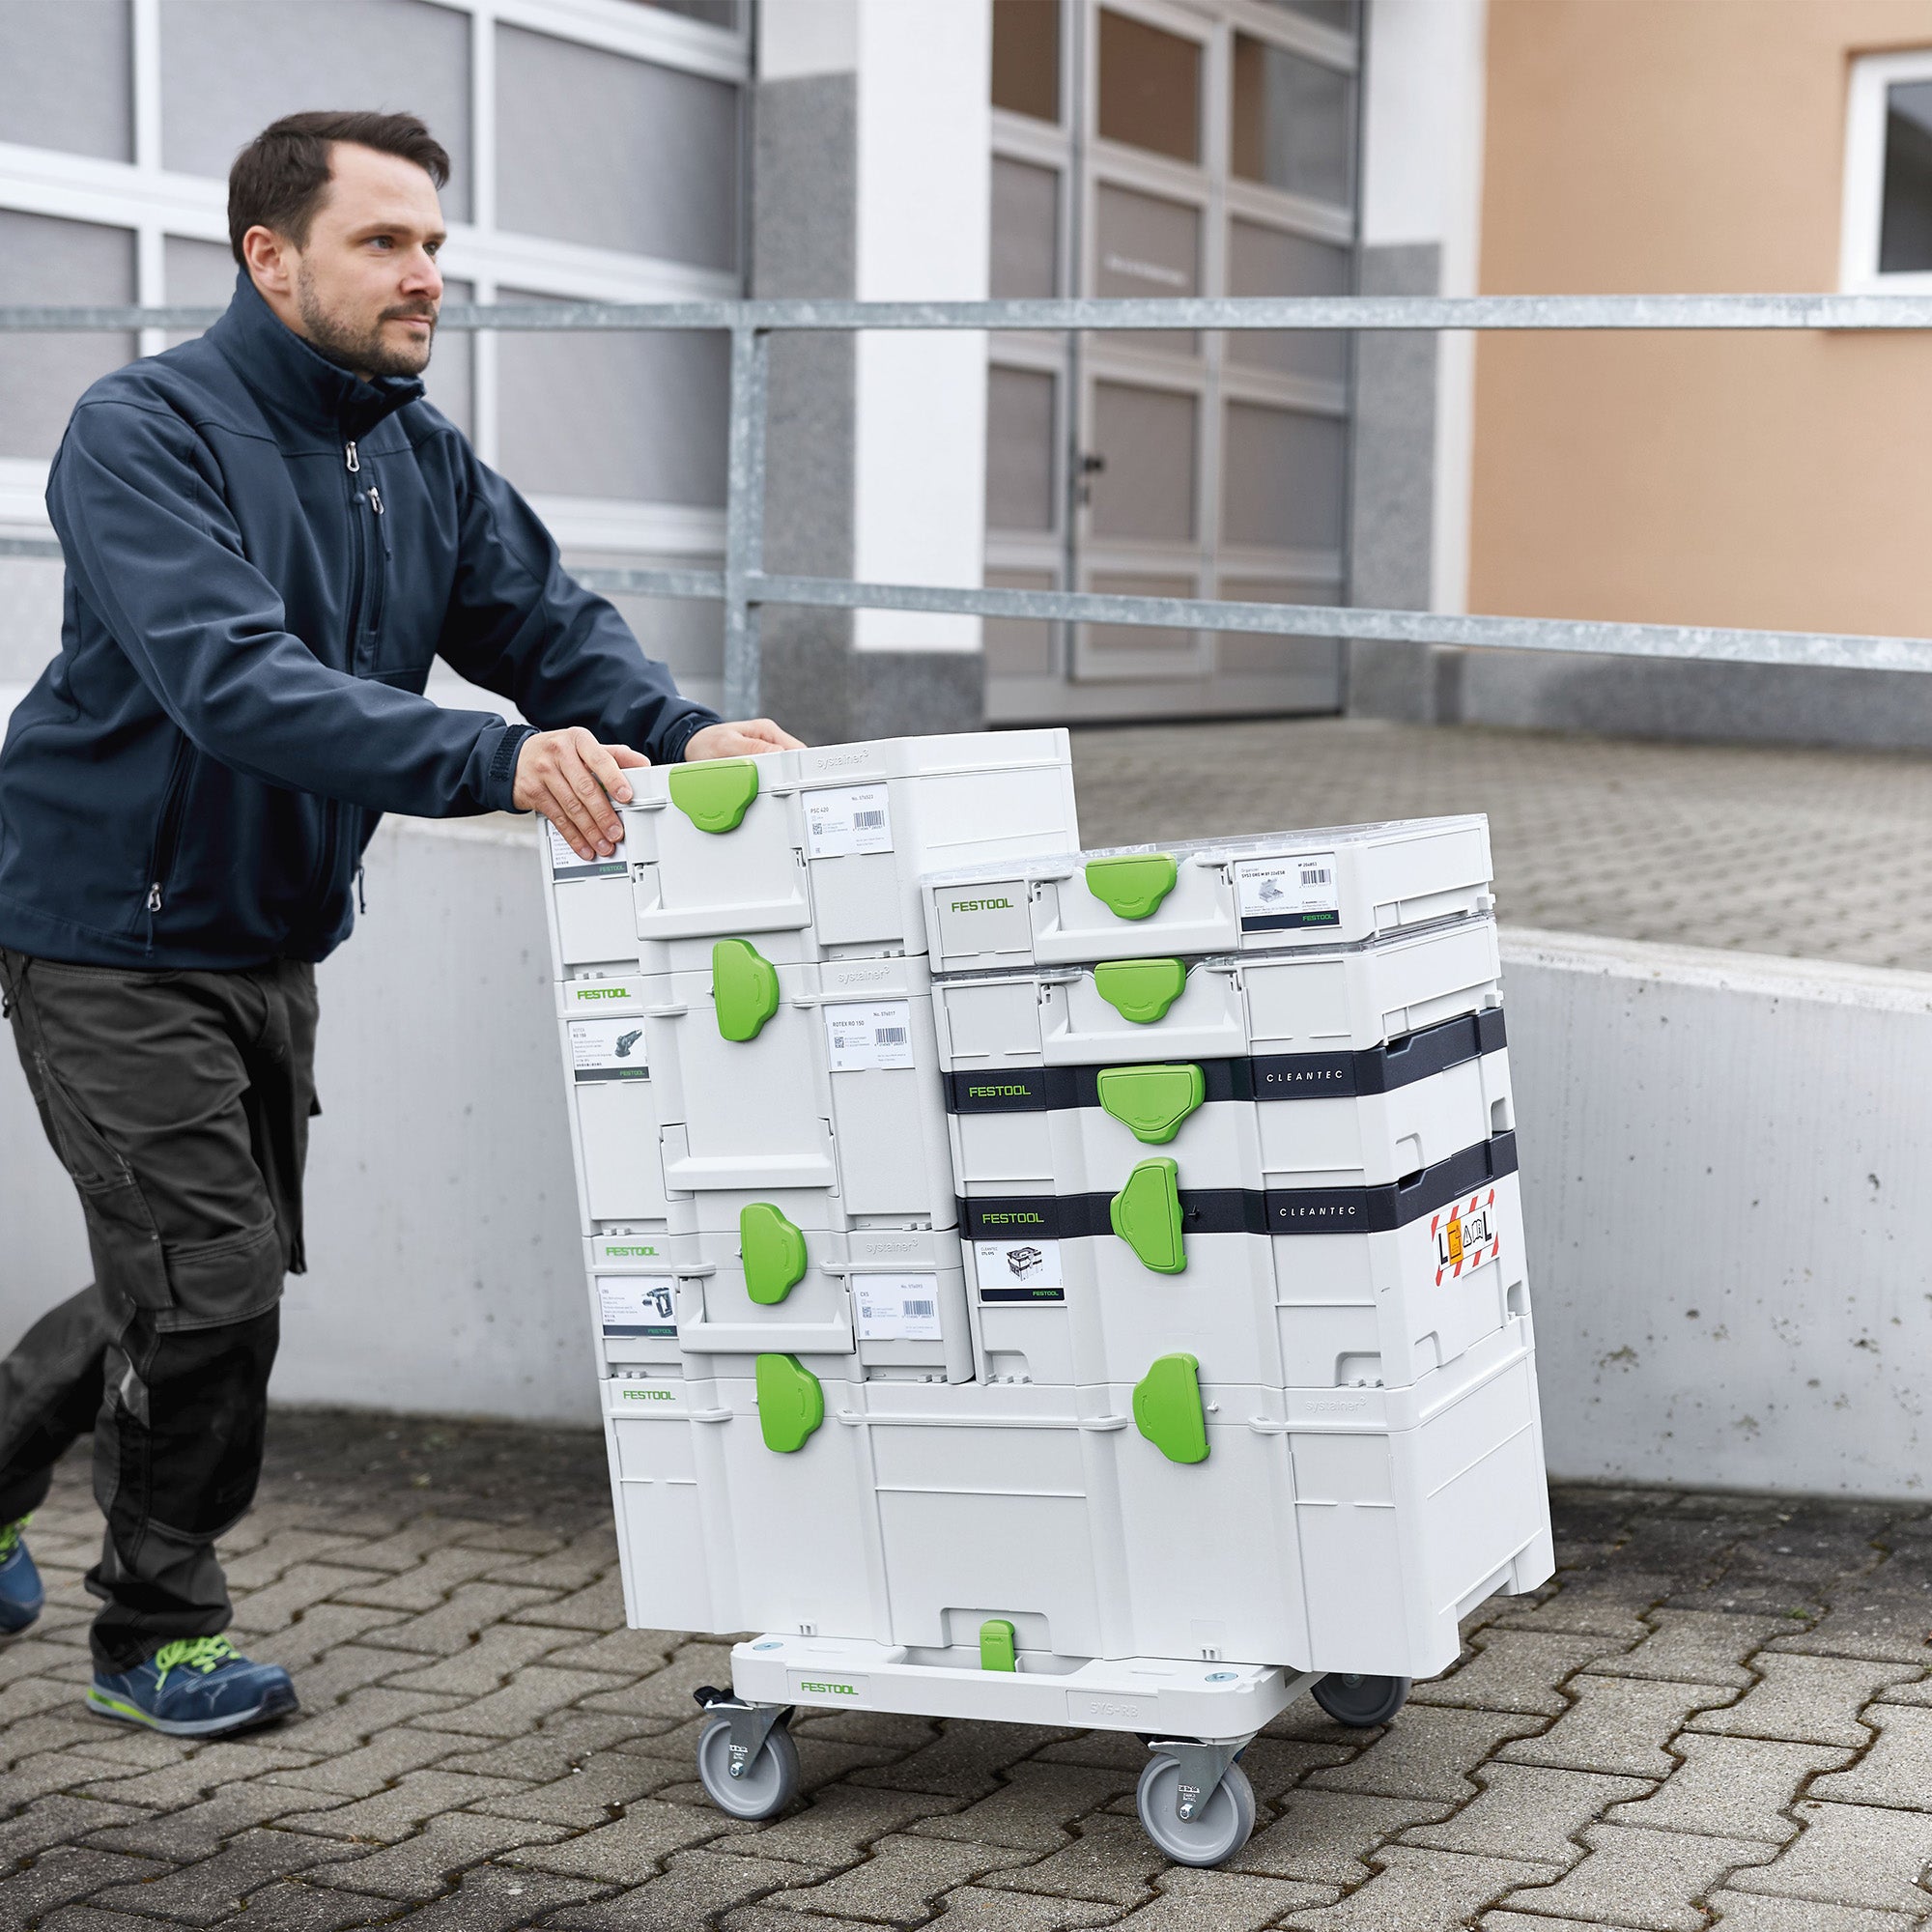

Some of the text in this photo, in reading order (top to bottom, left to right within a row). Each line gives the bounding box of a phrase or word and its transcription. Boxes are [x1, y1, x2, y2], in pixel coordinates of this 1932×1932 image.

[952, 897, 1014, 913] FESTOOL
[577, 987, 632, 1000] FESTOOL
[1266, 1069, 1343, 1083] CLEANTEC
[969, 1084, 1032, 1097] FESTOOL
[981, 1212, 1044, 1224] FESTOOL
[1279, 1206, 1356, 1217] CLEANTEC
[606, 1246, 660, 1256] FESTOOL
[623, 1390, 676, 1401] FESTOOL
[801, 1682, 859, 1695] FESTOOL
[1090, 1701, 1139, 1718] SYS-RB
